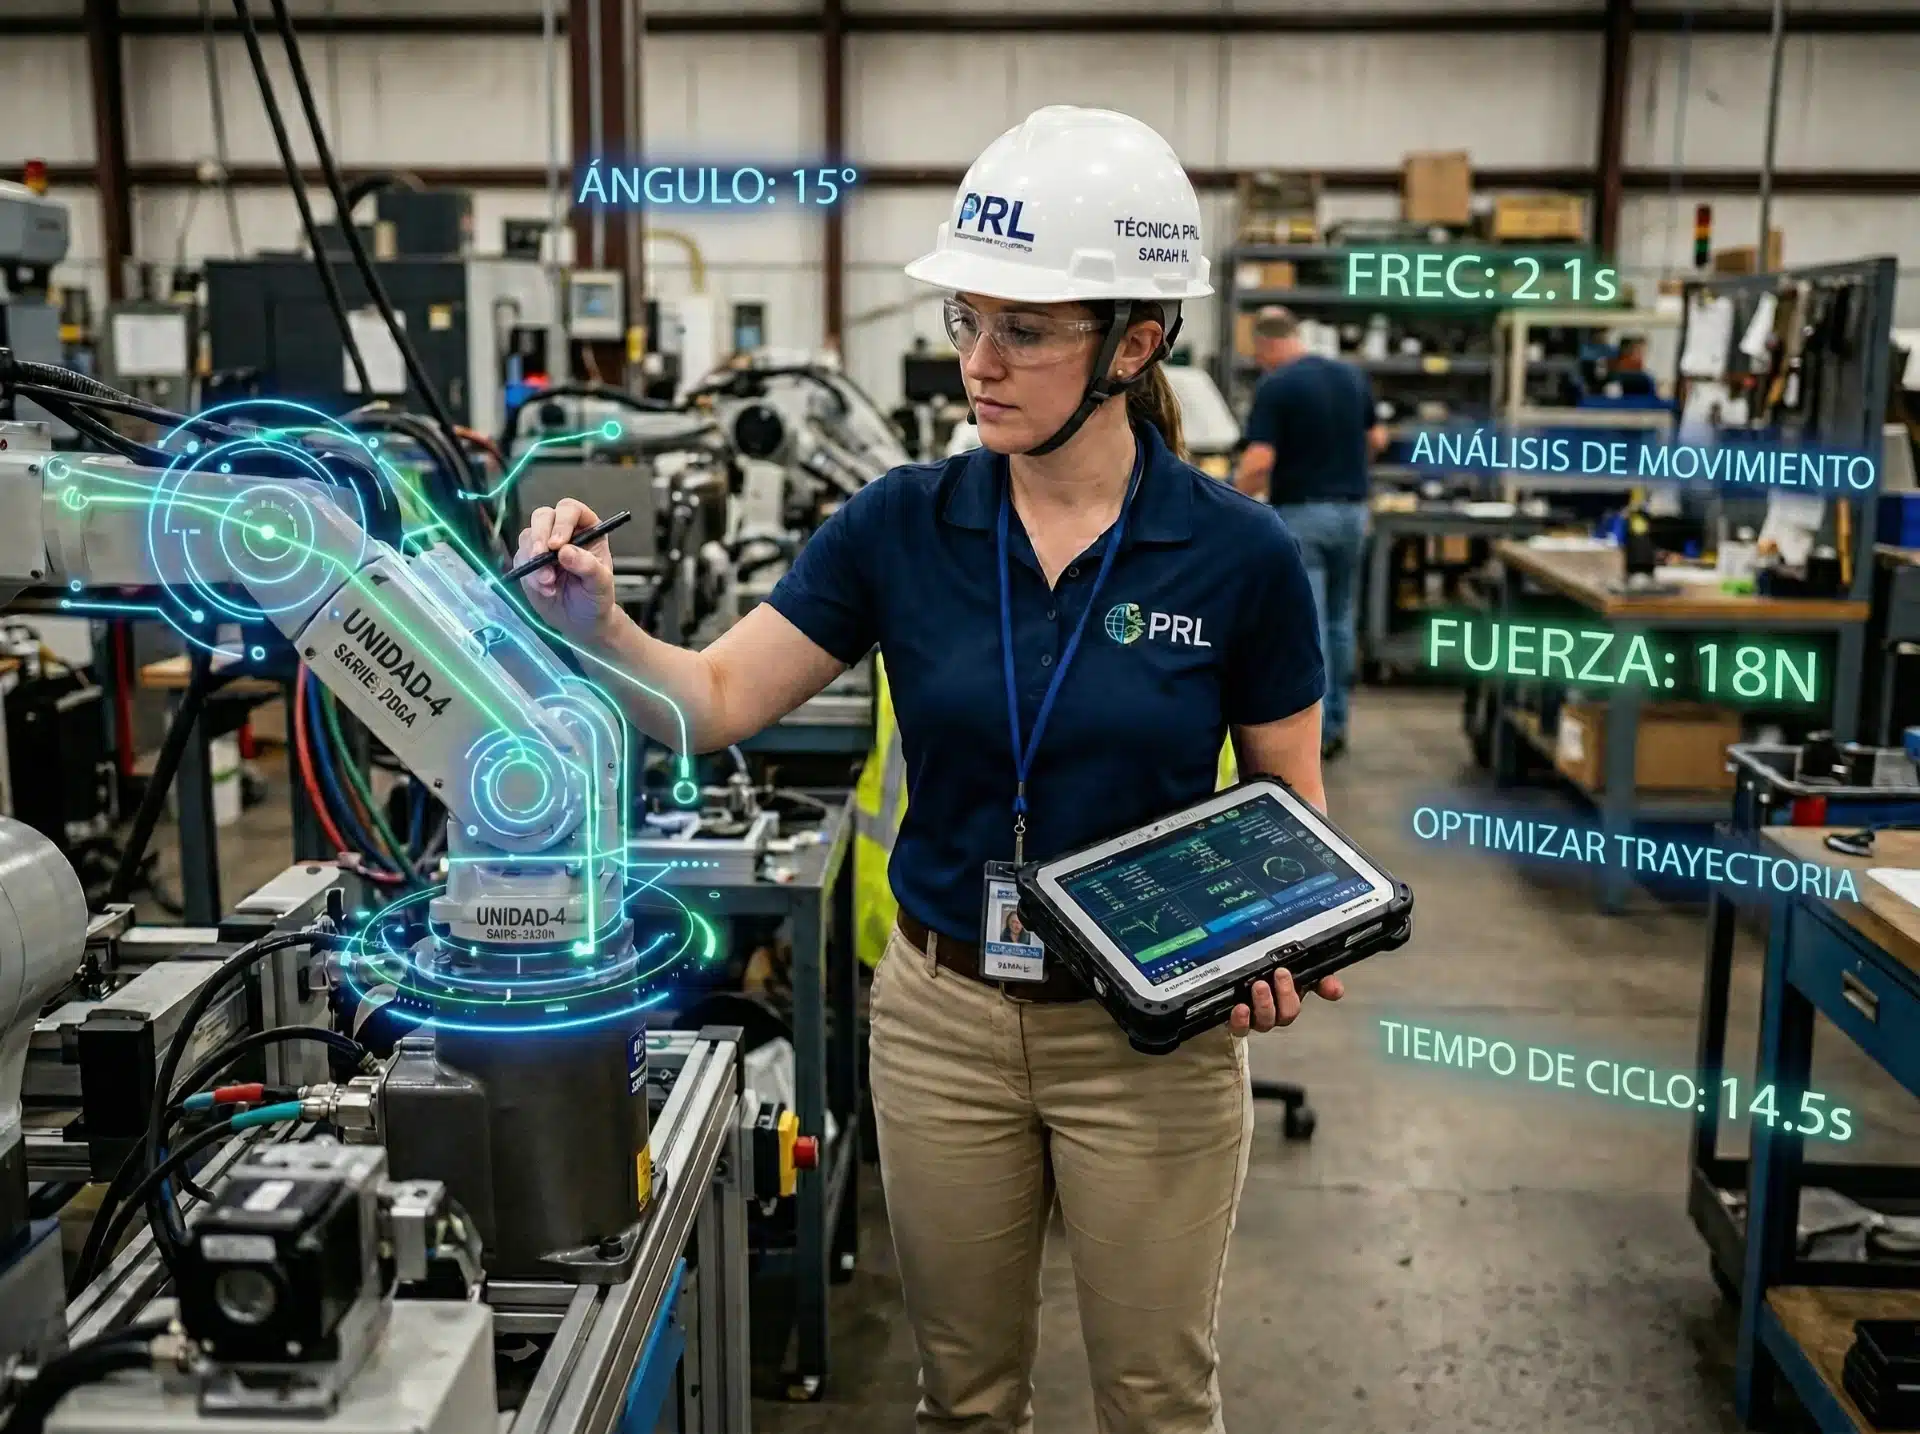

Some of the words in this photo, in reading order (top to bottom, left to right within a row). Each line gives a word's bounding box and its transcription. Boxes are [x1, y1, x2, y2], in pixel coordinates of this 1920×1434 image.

[957, 192, 1035, 242] PRL
[1113, 216, 1180, 240] TÉCNICA
[1182, 224, 1200, 240] PRL
[1138, 247, 1179, 262] SARAH
[1181, 249, 1189, 263] H.
[1148, 612, 1212, 647] PRL
[343, 607, 452, 717] UNIDAD-4
[476, 906, 567, 927] UNIDAD-4
